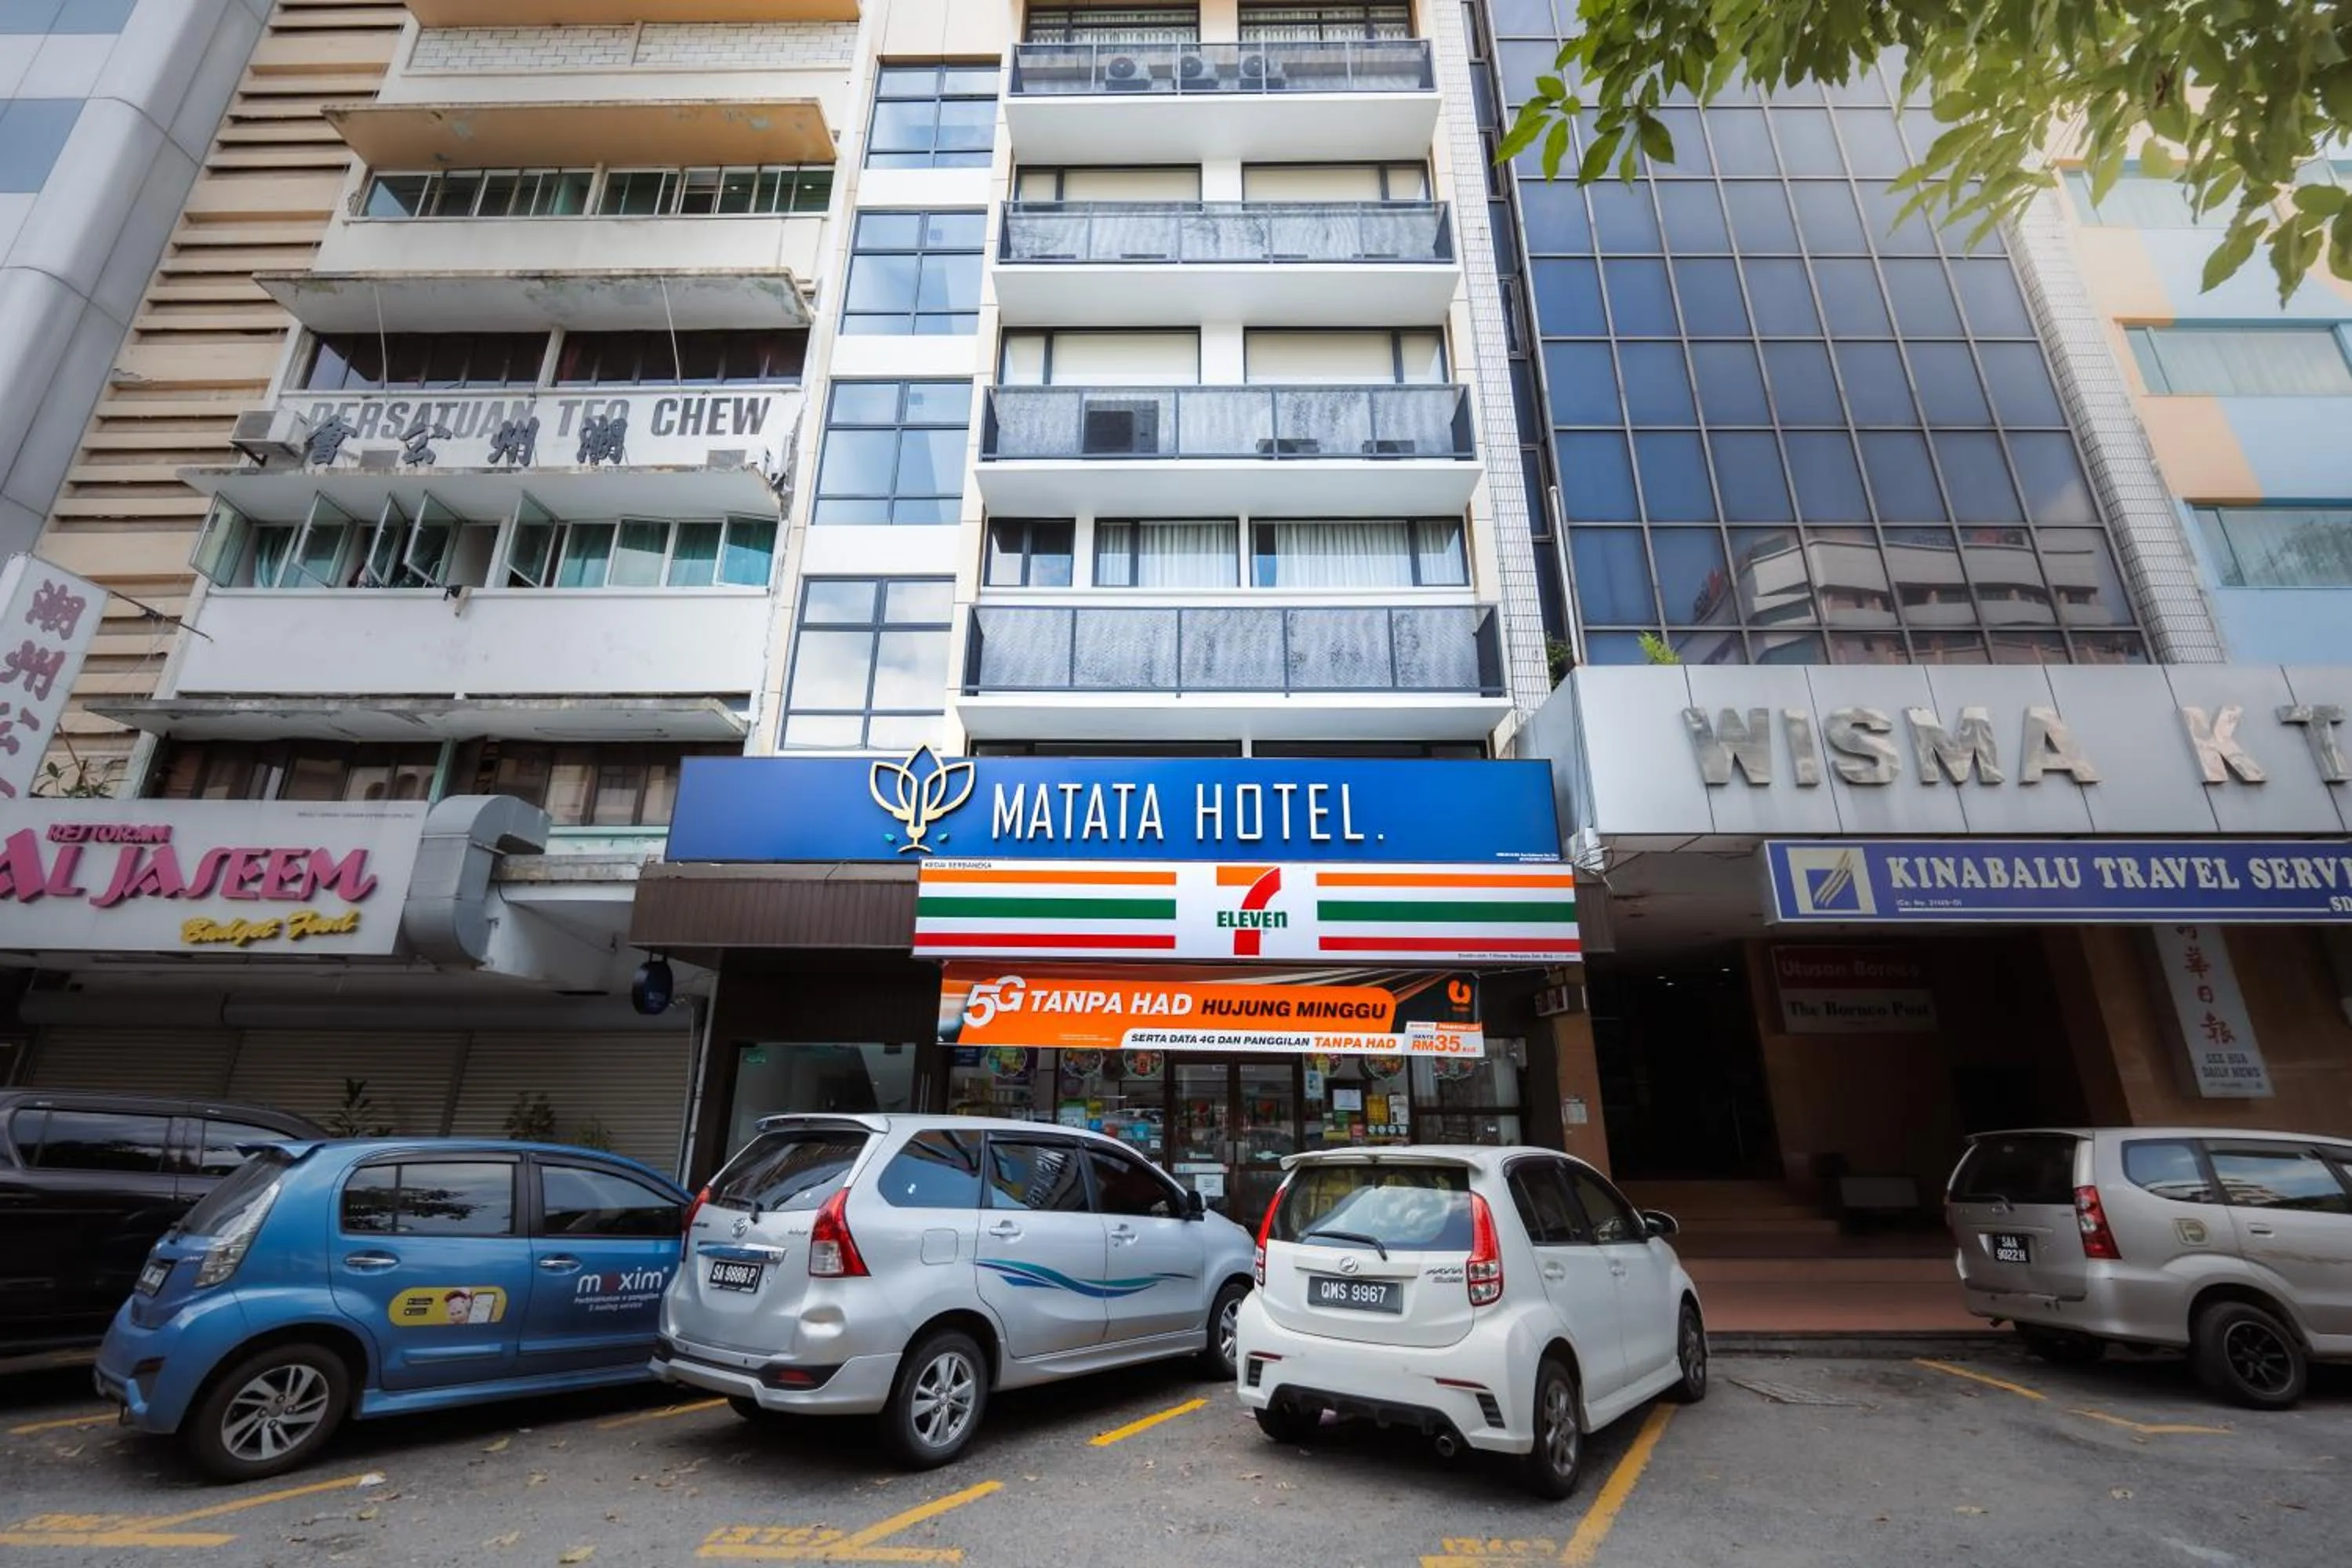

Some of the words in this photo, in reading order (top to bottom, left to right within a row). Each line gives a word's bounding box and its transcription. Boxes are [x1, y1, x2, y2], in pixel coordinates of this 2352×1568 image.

[309, 399, 535, 440] PERSATUAN
[651, 397, 770, 436] CHEW
[1682, 706, 2103, 785] WISMA
[992, 782, 1164, 840] MATATA
[0, 829, 85, 903] AL
[90, 844, 377, 907] JASEEM
[1887, 857, 2082, 889] KINABALU
[2094, 857, 2240, 888] TRAVEL
[1217, 866, 1281, 955] 7
[181, 917, 283, 947] Budget
[1781, 960, 1846, 978] Utusan
[964, 975, 1026, 1028] 5G
[1031, 990, 1123, 1014] TANPA
[1130, 992, 1192, 1015] HAD
[1201, 1000, 1291, 1018] HUJUNG
[1296, 1001, 1387, 1019] MINGGU
[1788, 1001, 1818, 1016] The
[1824, 1001, 1887, 1016] Borneo
[1892, 1001, 1929, 1017] Post
[1131, 1033, 1167, 1043] SERTA
[1169, 1034, 1197, 1044] DATA
[1200, 1035, 1215, 1044] 4G
[1218, 1036, 1241, 1045] DAN
[1243, 1036, 1310, 1047] PANGGILAN
[1314, 1037, 1362, 1048] TANPA
[1365, 1038, 1396, 1049] HAD
[2201, 1066, 2229, 1078] DAILY
[2232, 1066, 2261, 1078] NEWS
[2205, 1053, 2226, 1065] SEE
[2227, 1053, 2249, 1065] HUA
[712, 1265, 724, 1280] SA
[1321, 1283, 1346, 1299] QMS
[1351, 1285, 1387, 1304] 9967
